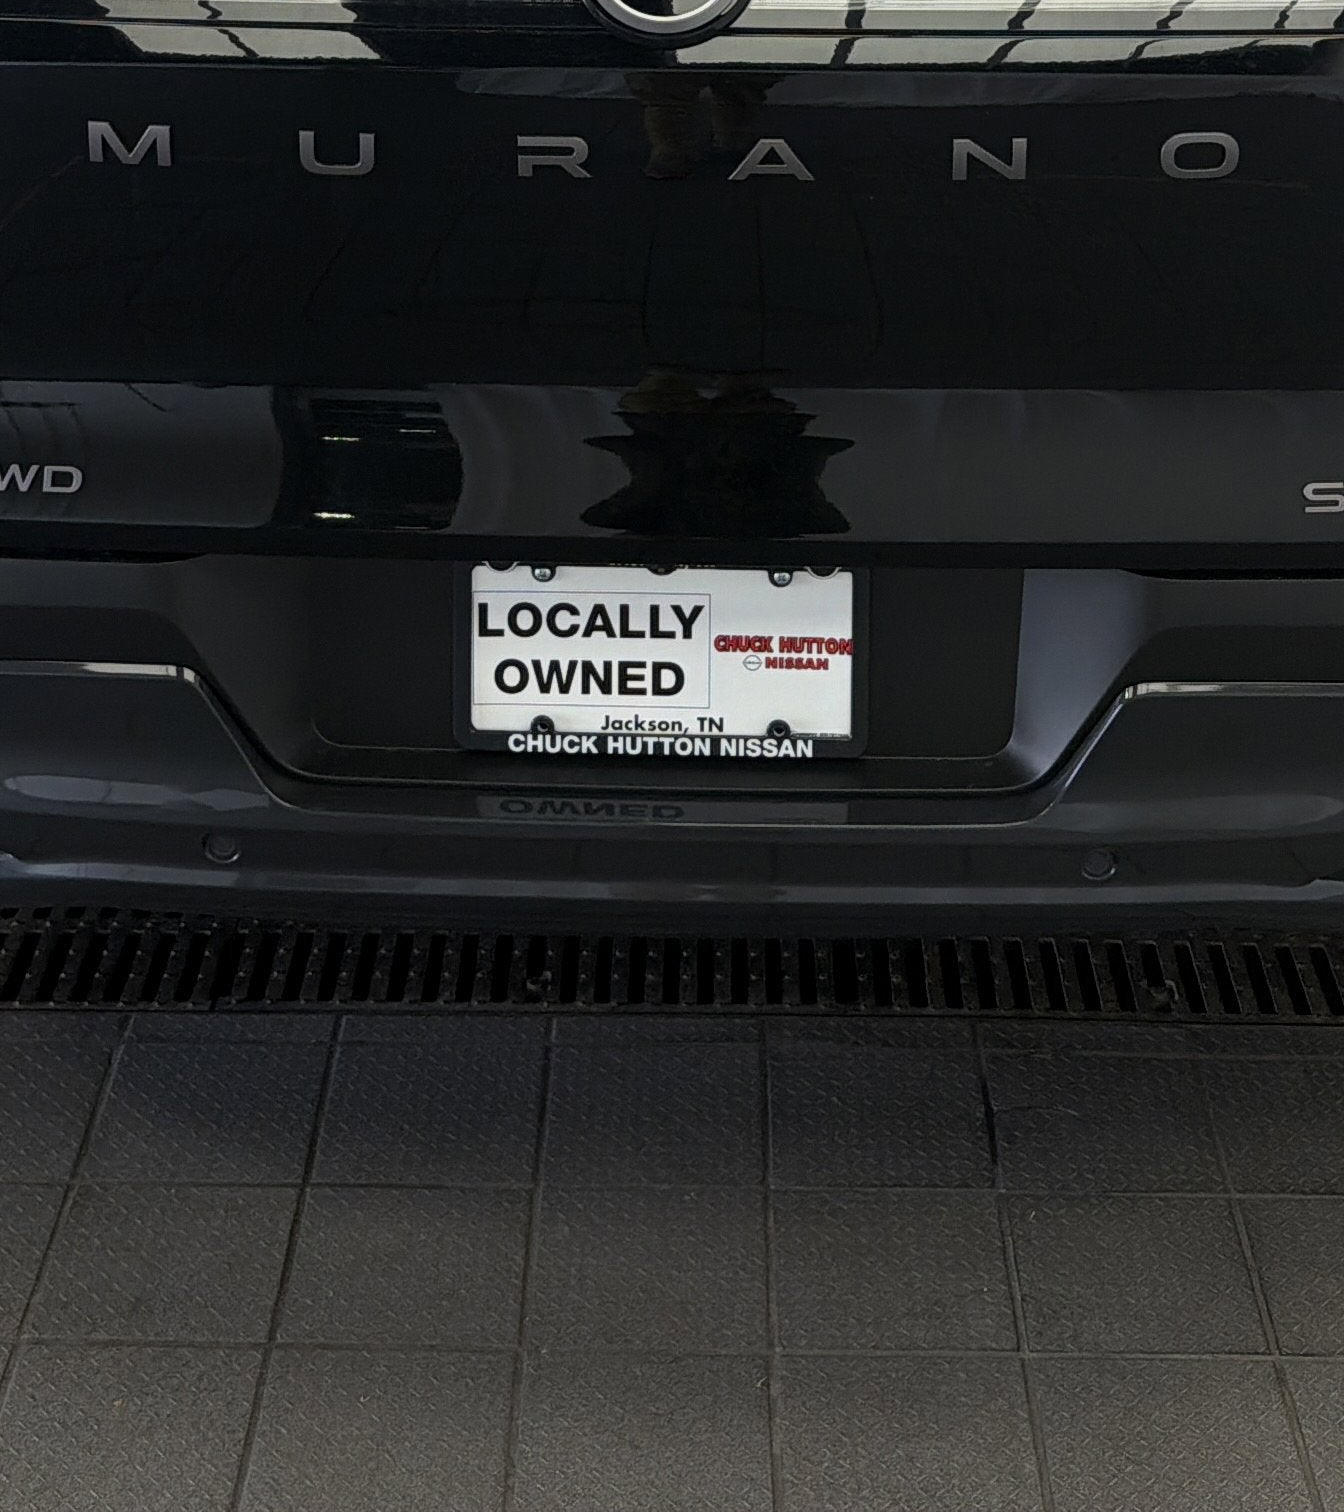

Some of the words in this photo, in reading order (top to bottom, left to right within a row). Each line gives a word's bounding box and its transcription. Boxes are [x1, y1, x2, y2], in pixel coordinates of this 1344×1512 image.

[86, 119, 1241, 182] MURANO
[477, 601, 705, 640] LOCALLY
[713, 635, 774, 654] CHUCK
[779, 636, 854, 656] HUTTON
[765, 657, 830, 671] NISSAN
[494, 658, 685, 697] OWNED
[600, 714, 689, 736] Jackson,
[697, 716, 725, 734] TN
[507, 733, 599, 755] CHUCK
[607, 735, 716, 757] HUTTON
[720, 737, 814, 759] NISSAN
